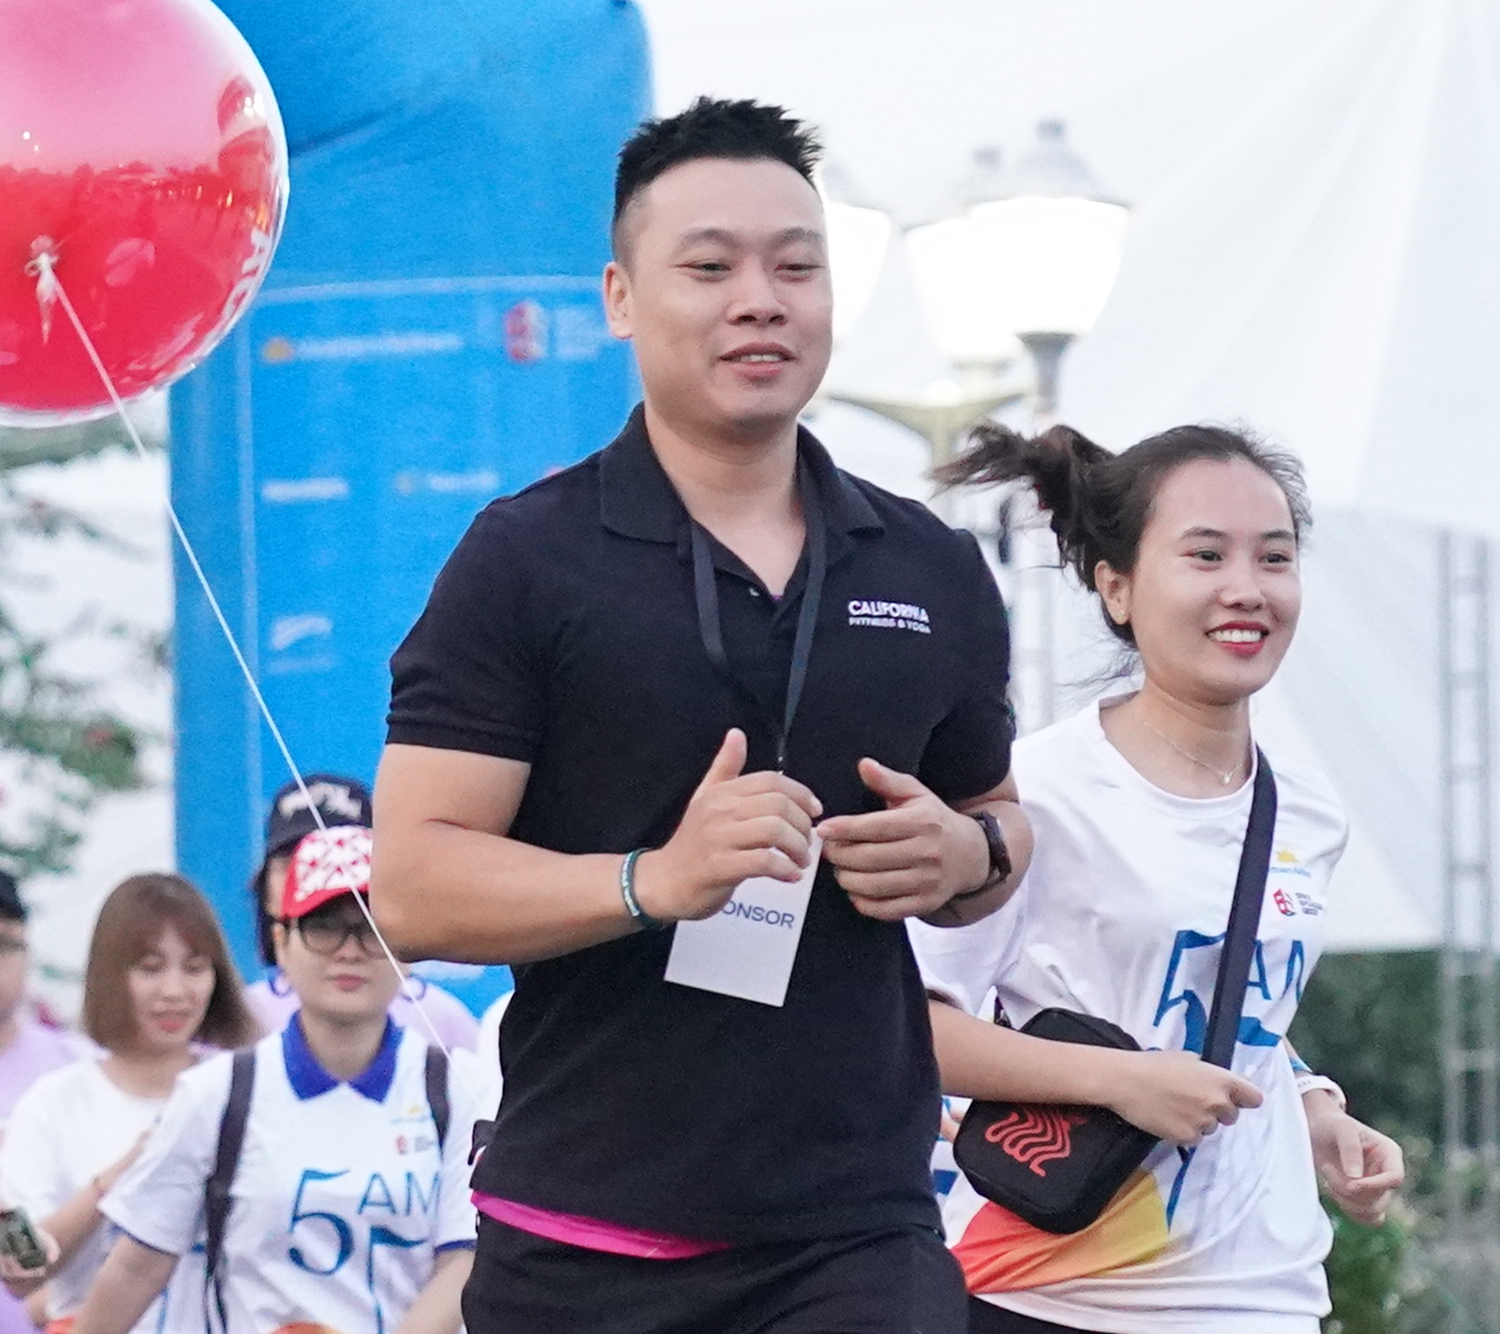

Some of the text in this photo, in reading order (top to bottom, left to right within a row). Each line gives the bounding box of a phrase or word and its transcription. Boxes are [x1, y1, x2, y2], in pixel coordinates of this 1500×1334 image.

[848, 600, 930, 623] CALIFORNIA
[722, 900, 796, 929] ONSOR
[288, 1168, 441, 1276] 5 AM
